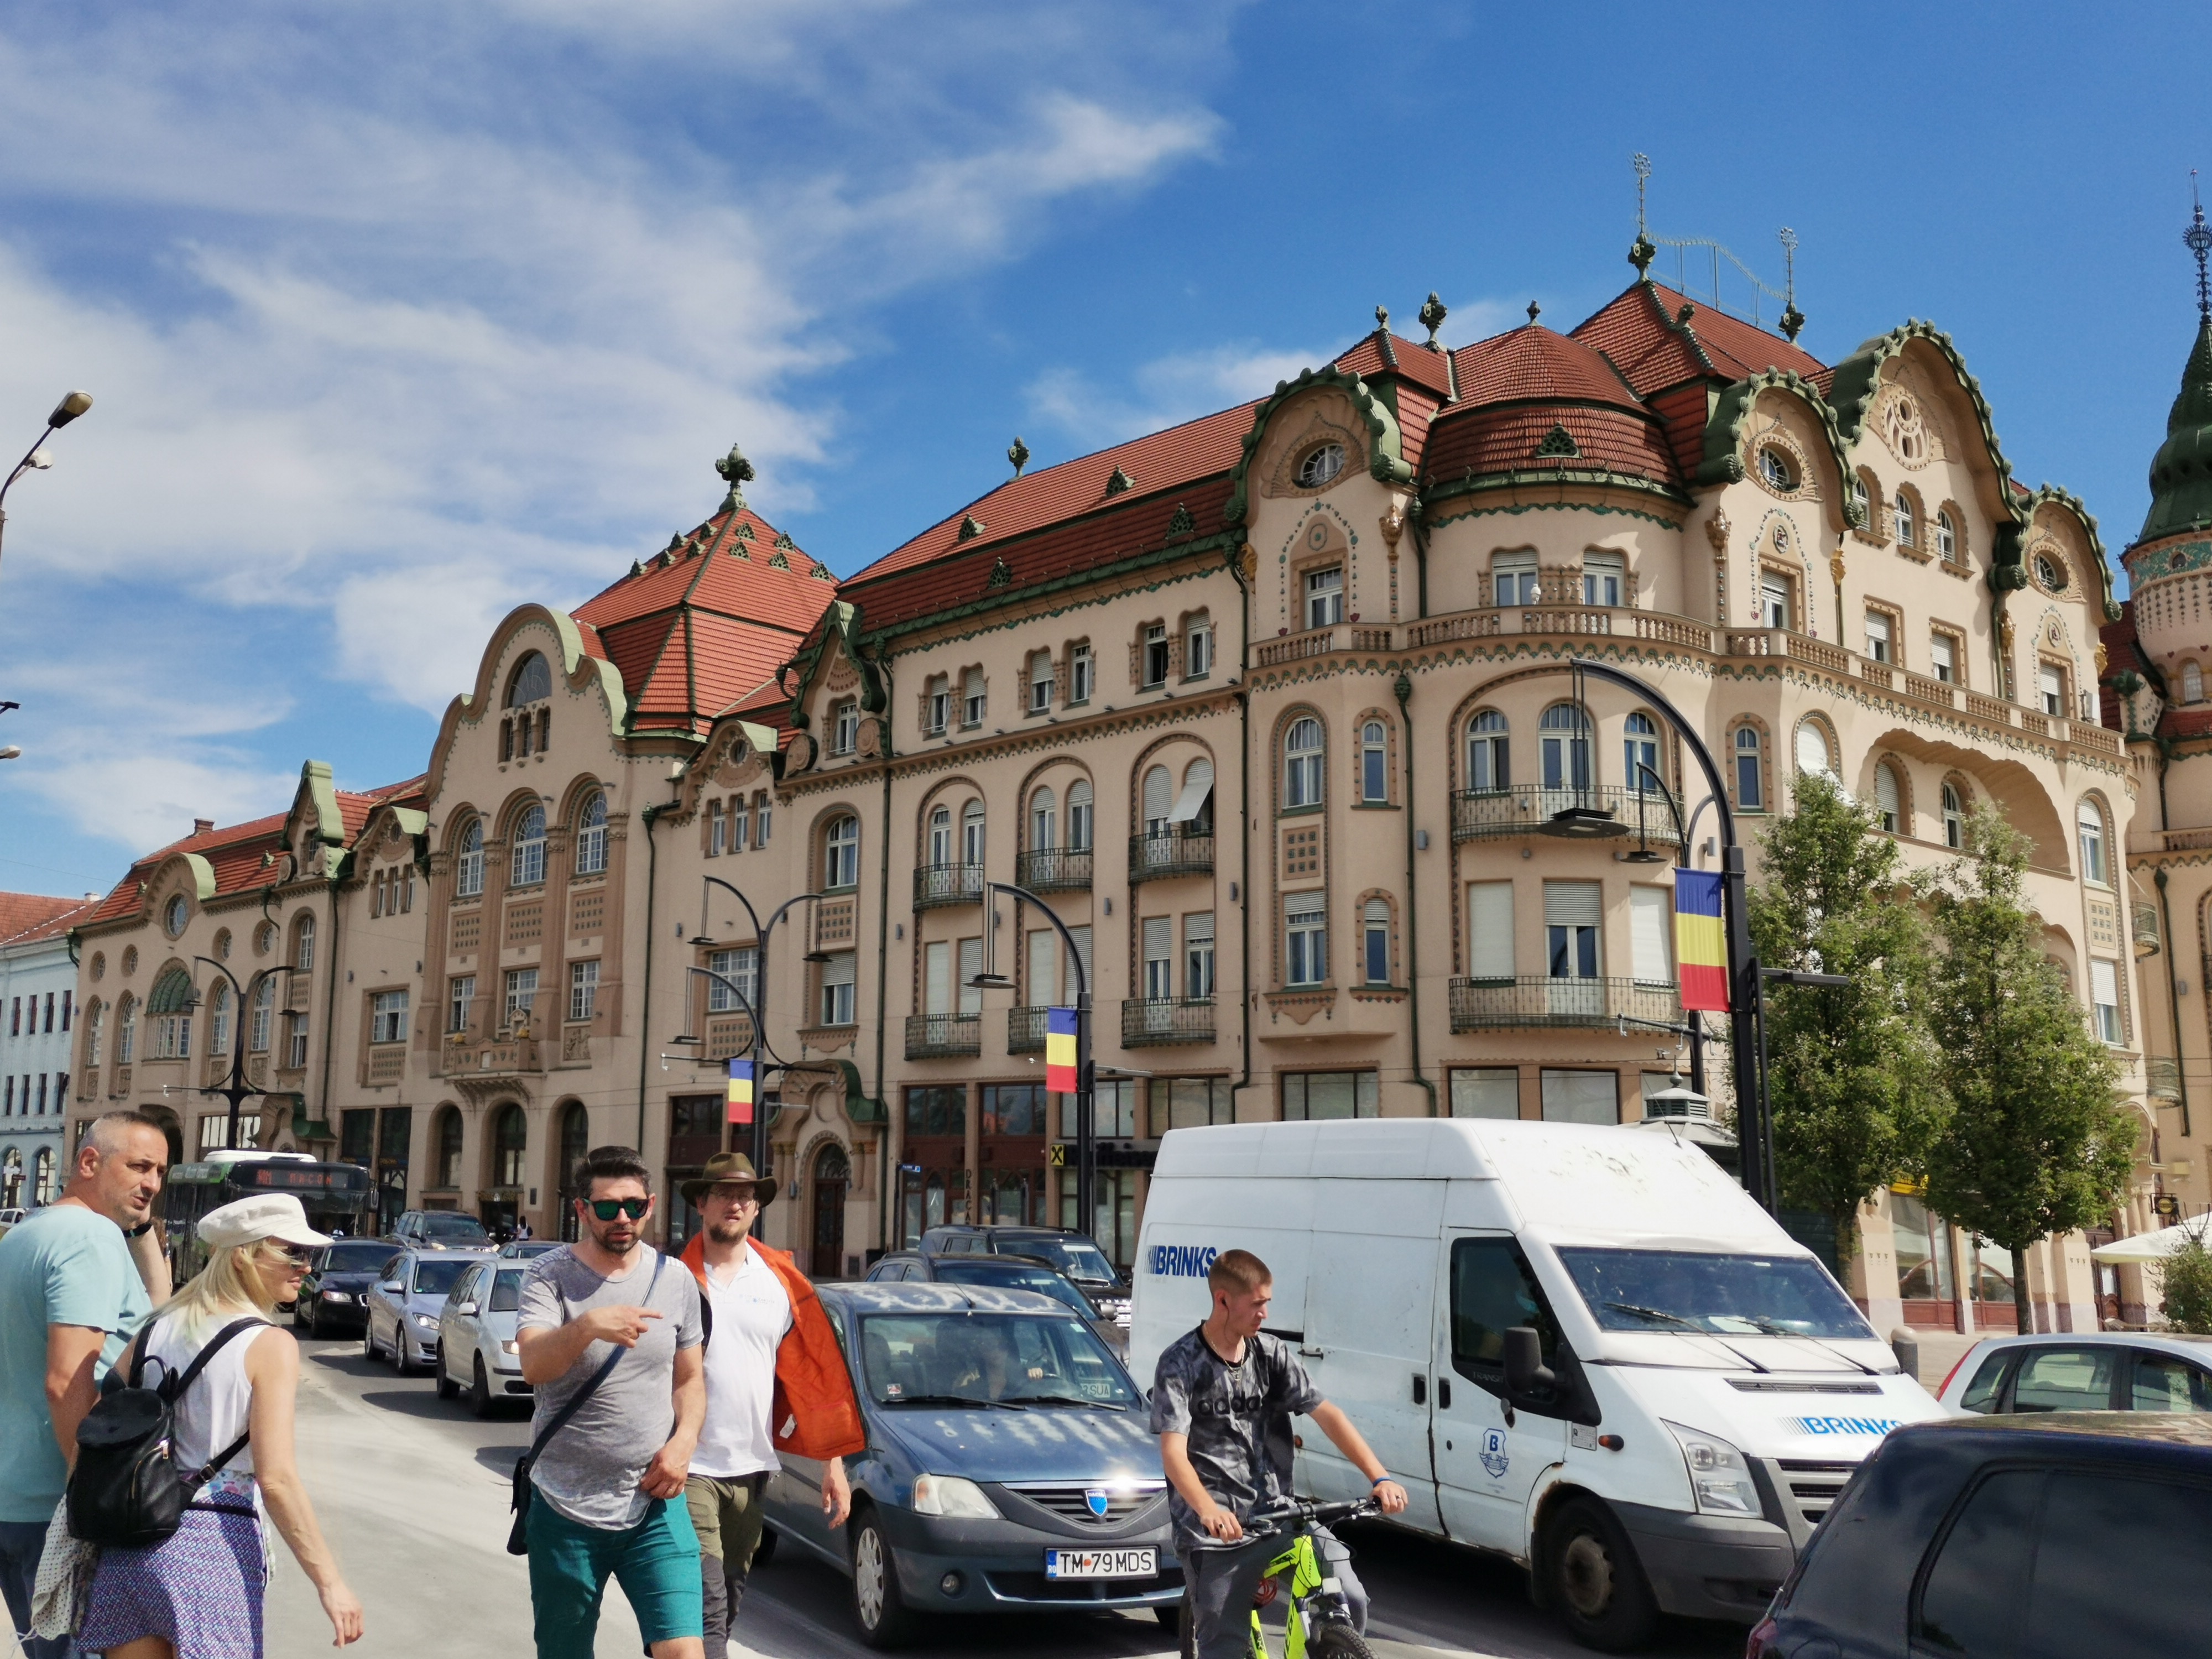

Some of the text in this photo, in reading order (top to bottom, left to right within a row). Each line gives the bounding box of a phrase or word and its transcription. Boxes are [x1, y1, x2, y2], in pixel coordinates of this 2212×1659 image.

[1154, 1245, 1217, 1278] BRINKS
[1489, 1434, 1498, 1452] B
[1048, 1564, 1056, 1574] RO
[1060, 1552, 1152, 1573] TM 79 MDS
